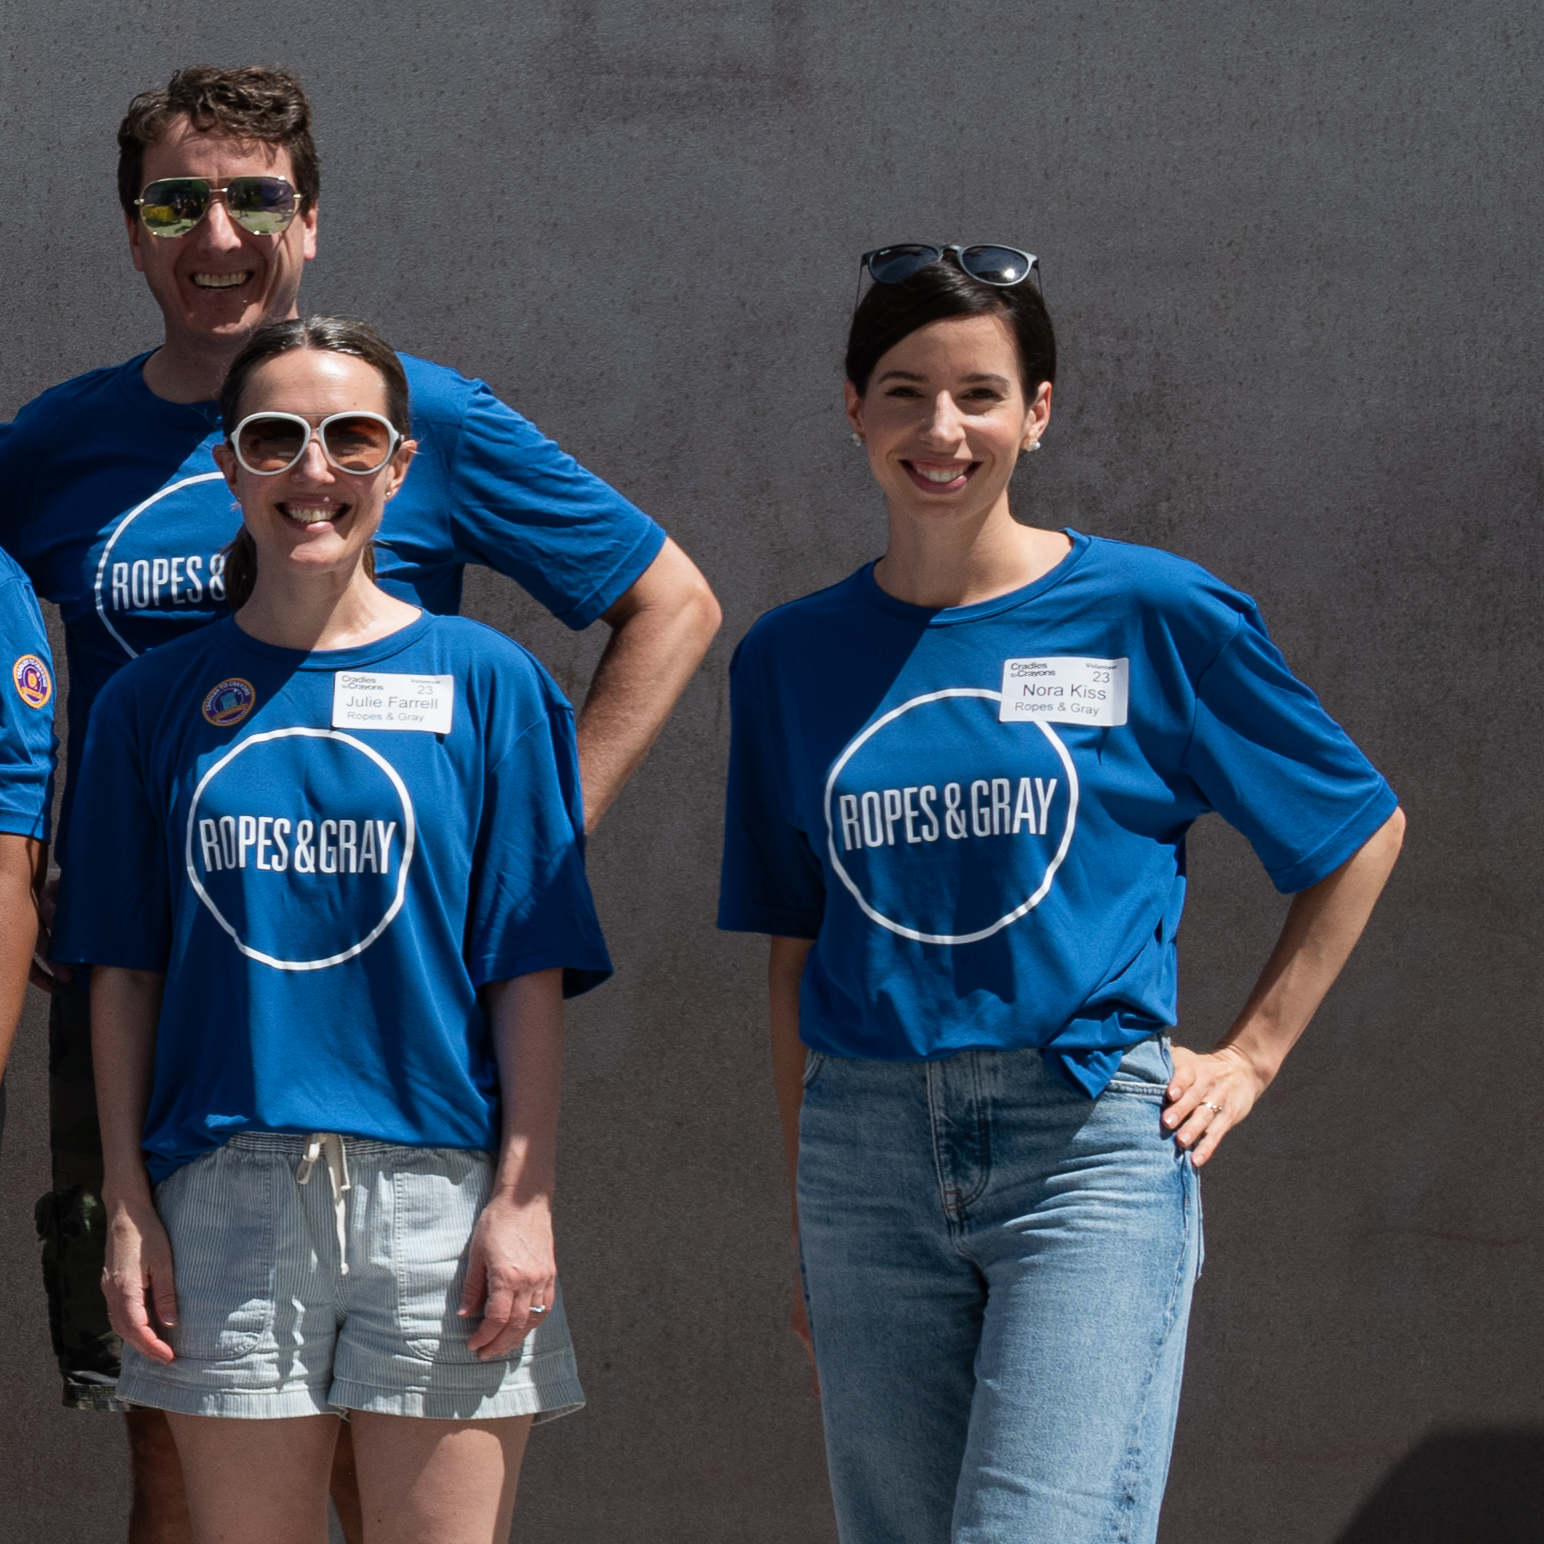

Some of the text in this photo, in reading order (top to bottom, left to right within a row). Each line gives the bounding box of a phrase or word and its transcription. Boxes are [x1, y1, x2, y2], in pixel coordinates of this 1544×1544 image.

[112, 555, 203, 611] ROPES
[1092, 671, 1110, 683] 23
[417, 685, 433, 695] 23
[1023, 684, 1107, 700] Nora Kiss
[346, 696, 438, 709] Julie Farrell
[839, 777, 1058, 851] ROPES & GRAY
[198, 815, 396, 876] ROPES & GRAY
